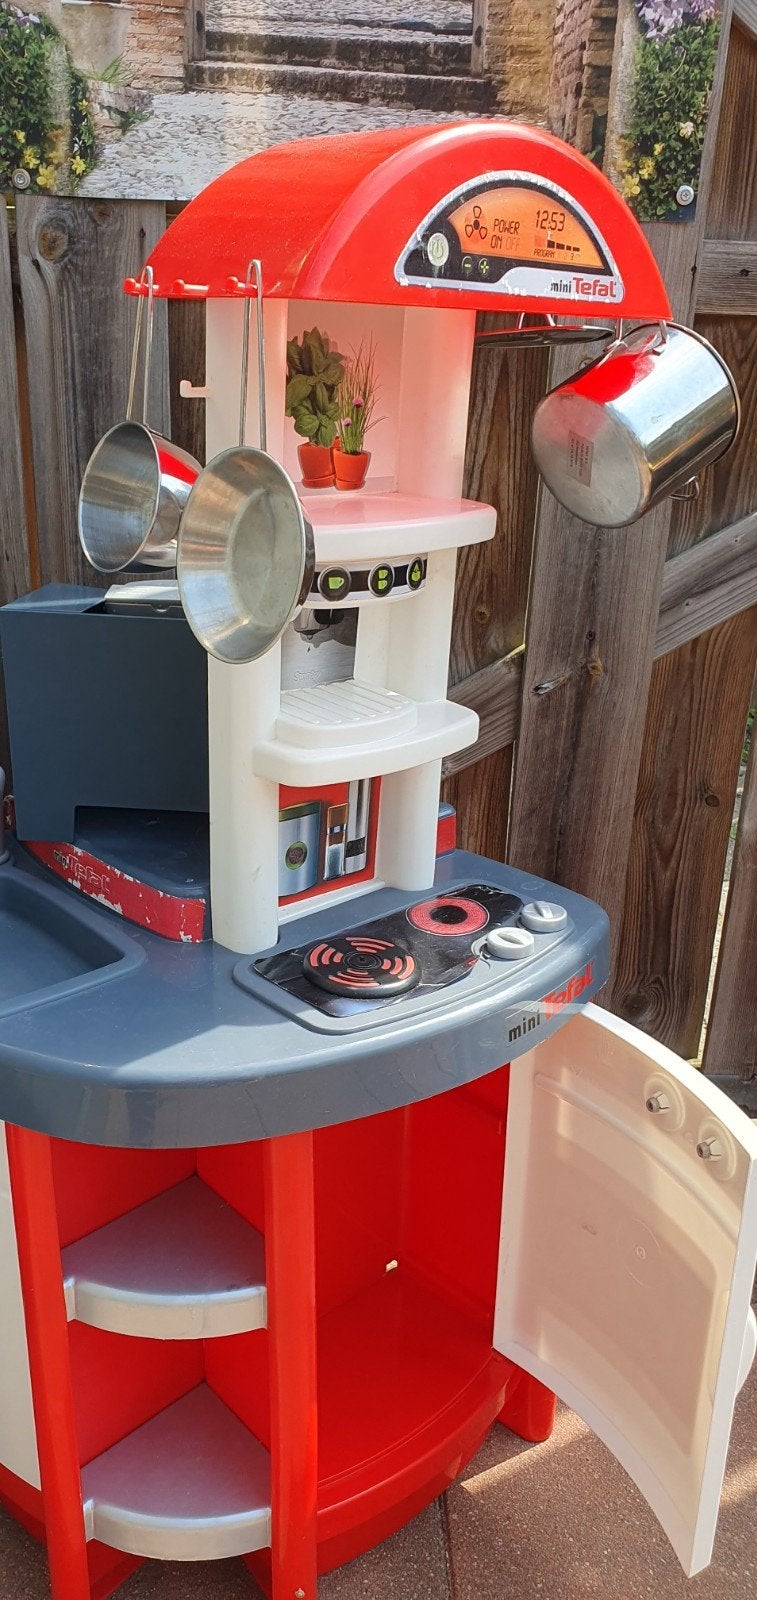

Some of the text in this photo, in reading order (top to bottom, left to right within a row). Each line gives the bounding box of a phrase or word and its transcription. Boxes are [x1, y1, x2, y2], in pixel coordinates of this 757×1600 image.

[493, 218, 520, 235] POWER
[536, 210, 566, 232] 12:53
[490, 234, 503, 249] ON
[533, 248, 556, 259] PROGRAM
[550, 276, 617, 298] mini Tefal
[508, 959, 594, 1042] mini Tefal
